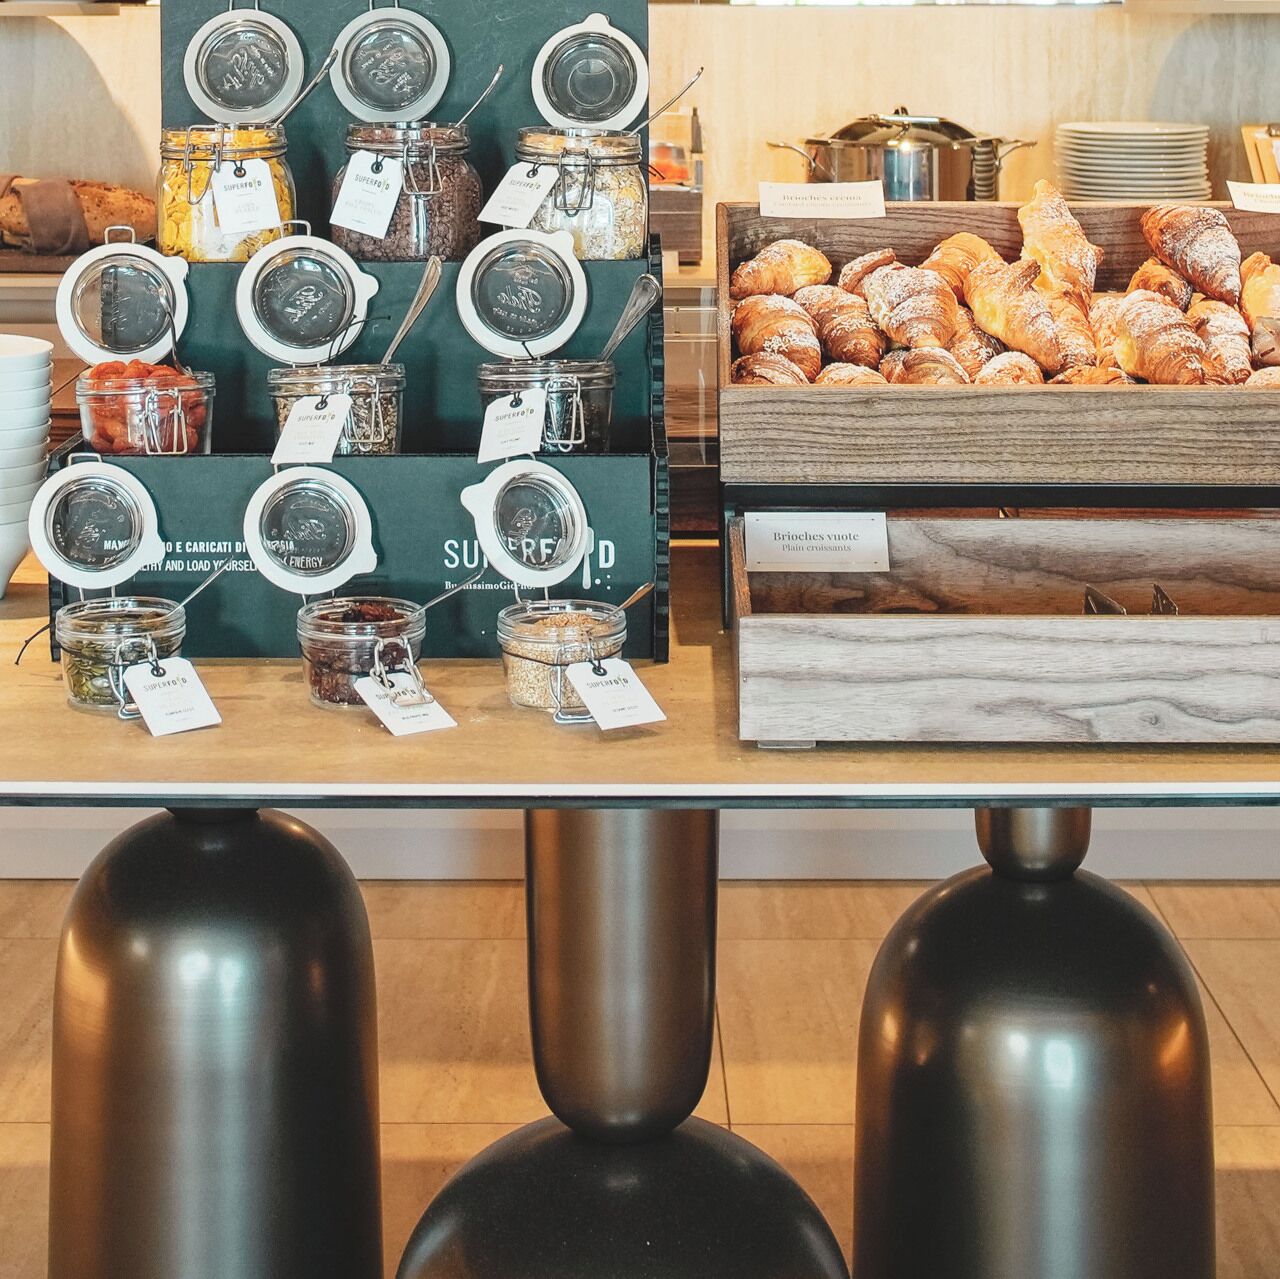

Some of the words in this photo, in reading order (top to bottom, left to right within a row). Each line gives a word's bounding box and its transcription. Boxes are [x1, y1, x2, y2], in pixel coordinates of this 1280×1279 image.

[773, 531, 825, 541] Brioches
[826, 533, 859, 541] vuote
[176, 542, 182, 553] E
[185, 541, 232, 553] CARICATI
[235, 541, 246, 553] DI
[782, 543, 805, 552] Plain
[806, 544, 852, 552] croissants
[165, 560, 184, 571] AND
[187, 560, 210, 571] LOAD
[289, 556, 323, 569] ENERGY
